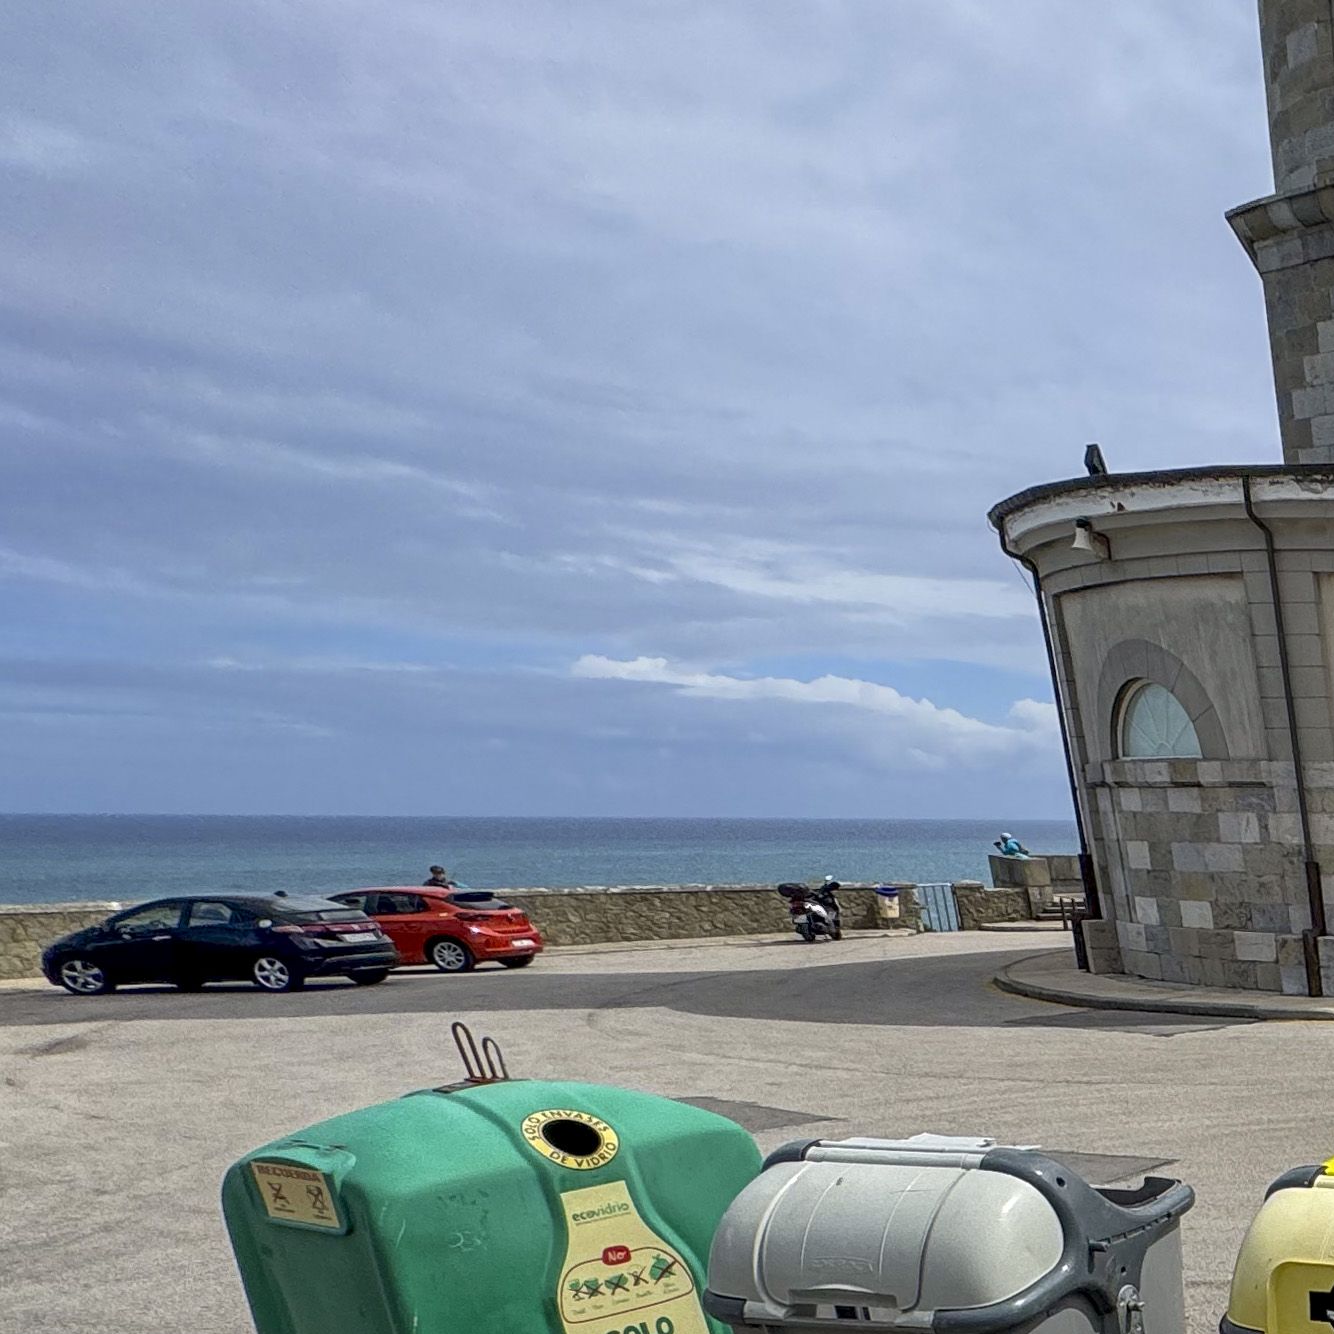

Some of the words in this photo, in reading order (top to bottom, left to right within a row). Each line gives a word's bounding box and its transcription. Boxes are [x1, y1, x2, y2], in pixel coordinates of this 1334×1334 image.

[524, 1116, 541, 1141] SOLO
[541, 1111, 609, 1133] ENVASES
[549, 1150, 567, 1164] DE
[574, 1141, 617, 1168] VIDRIO
[256, 1164, 322, 1183] RECUERDA
[572, 1202, 630, 1221] ecovidrio
